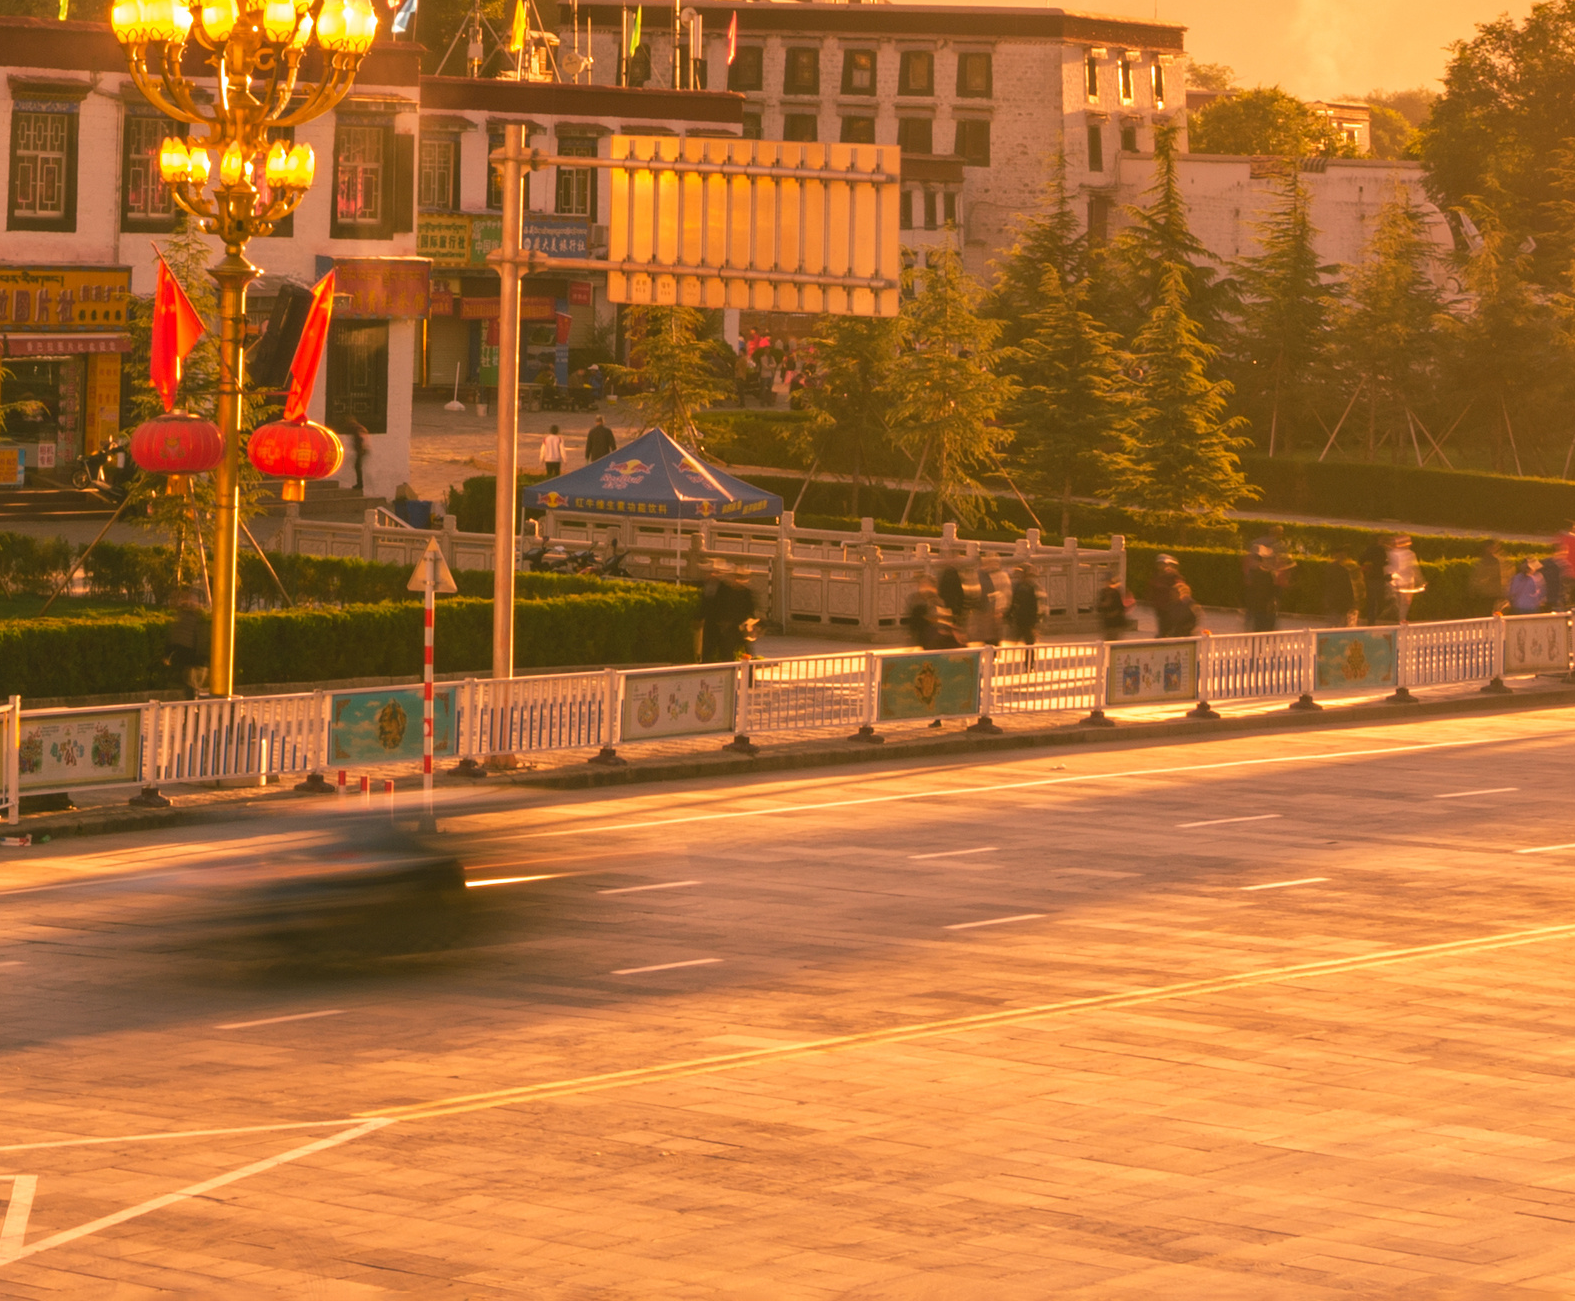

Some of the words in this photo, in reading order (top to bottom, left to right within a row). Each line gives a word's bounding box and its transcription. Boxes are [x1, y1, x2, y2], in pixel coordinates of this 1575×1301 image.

[417, 234, 465, 249] 国际旅行社
[574, 496, 668, 515] 红牛维生素功能饮料
